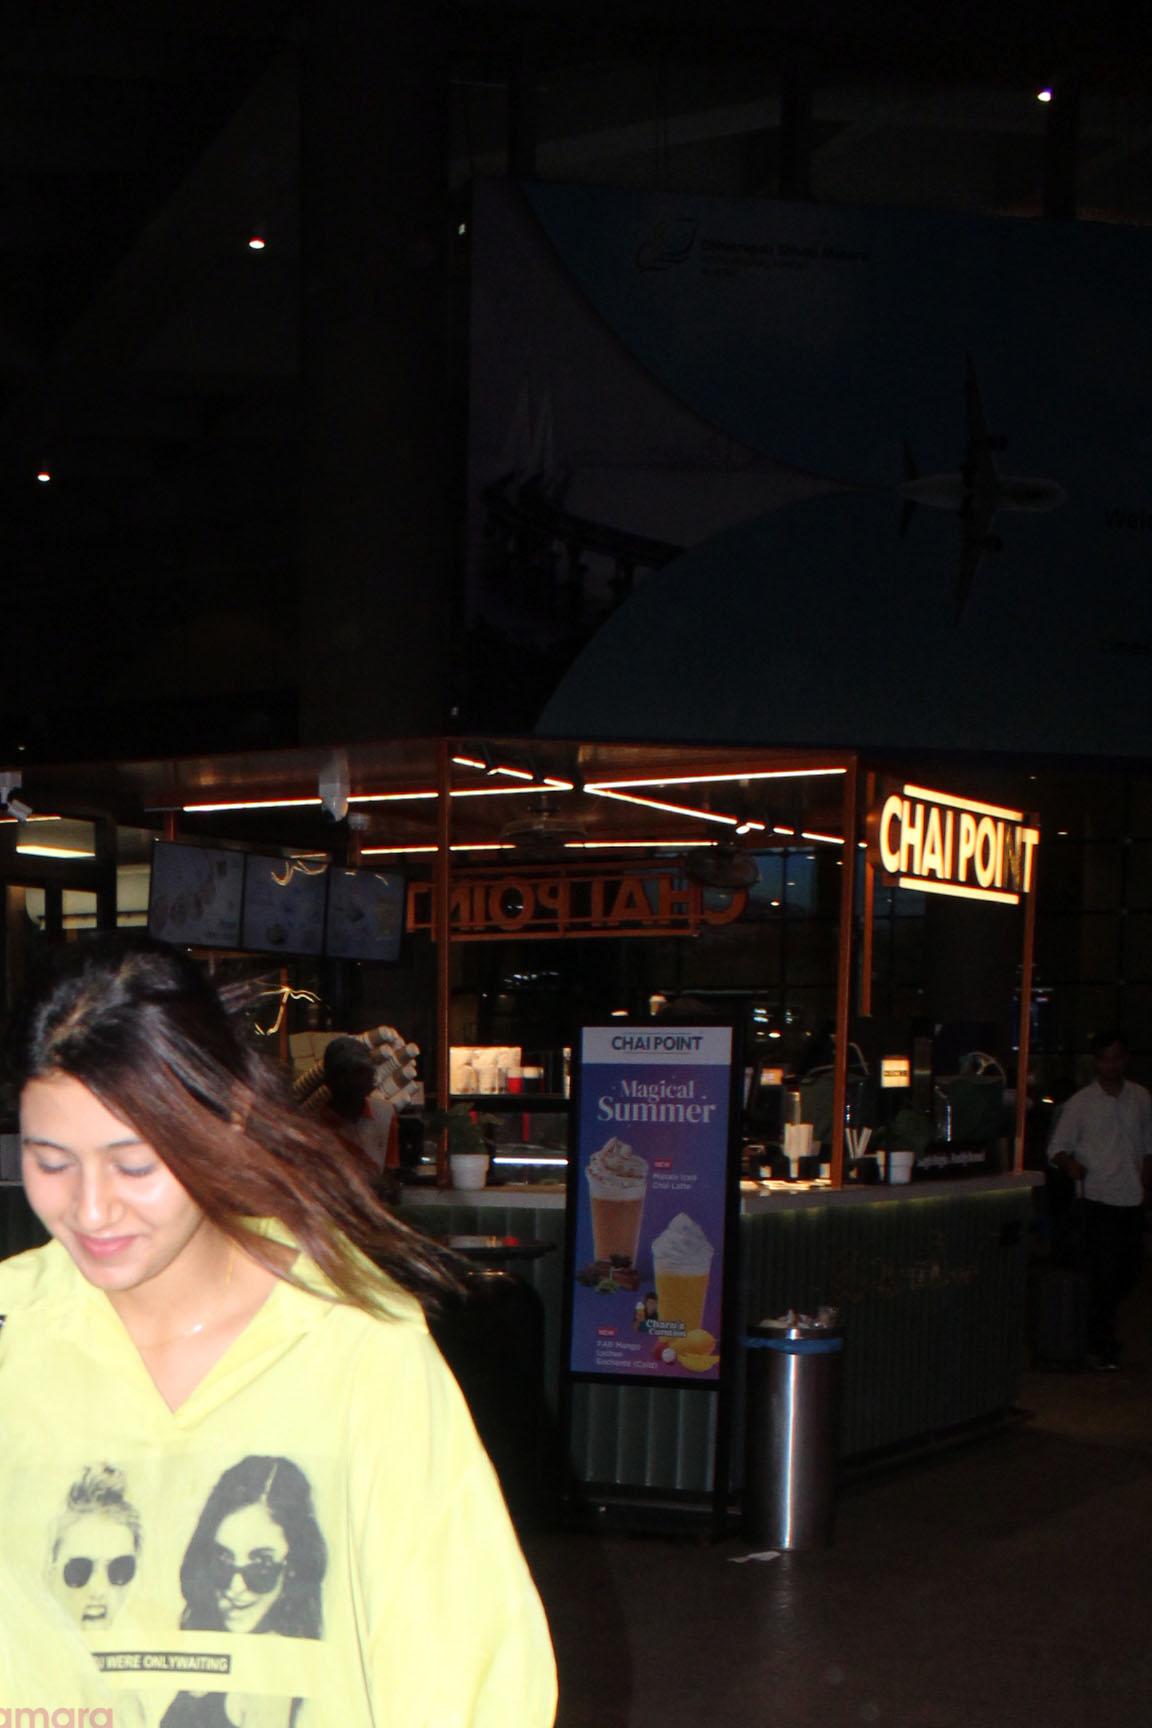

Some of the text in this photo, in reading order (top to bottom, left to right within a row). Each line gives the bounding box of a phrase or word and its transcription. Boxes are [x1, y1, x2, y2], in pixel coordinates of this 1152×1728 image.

[880, 795, 1040, 893] CHAI POINT
[612, 1036, 703, 1050] CHAI POINT
[621, 1080, 695, 1102] Magical
[598, 1096, 716, 1122] Summer
[106, 1655, 142, 1669] WERE
